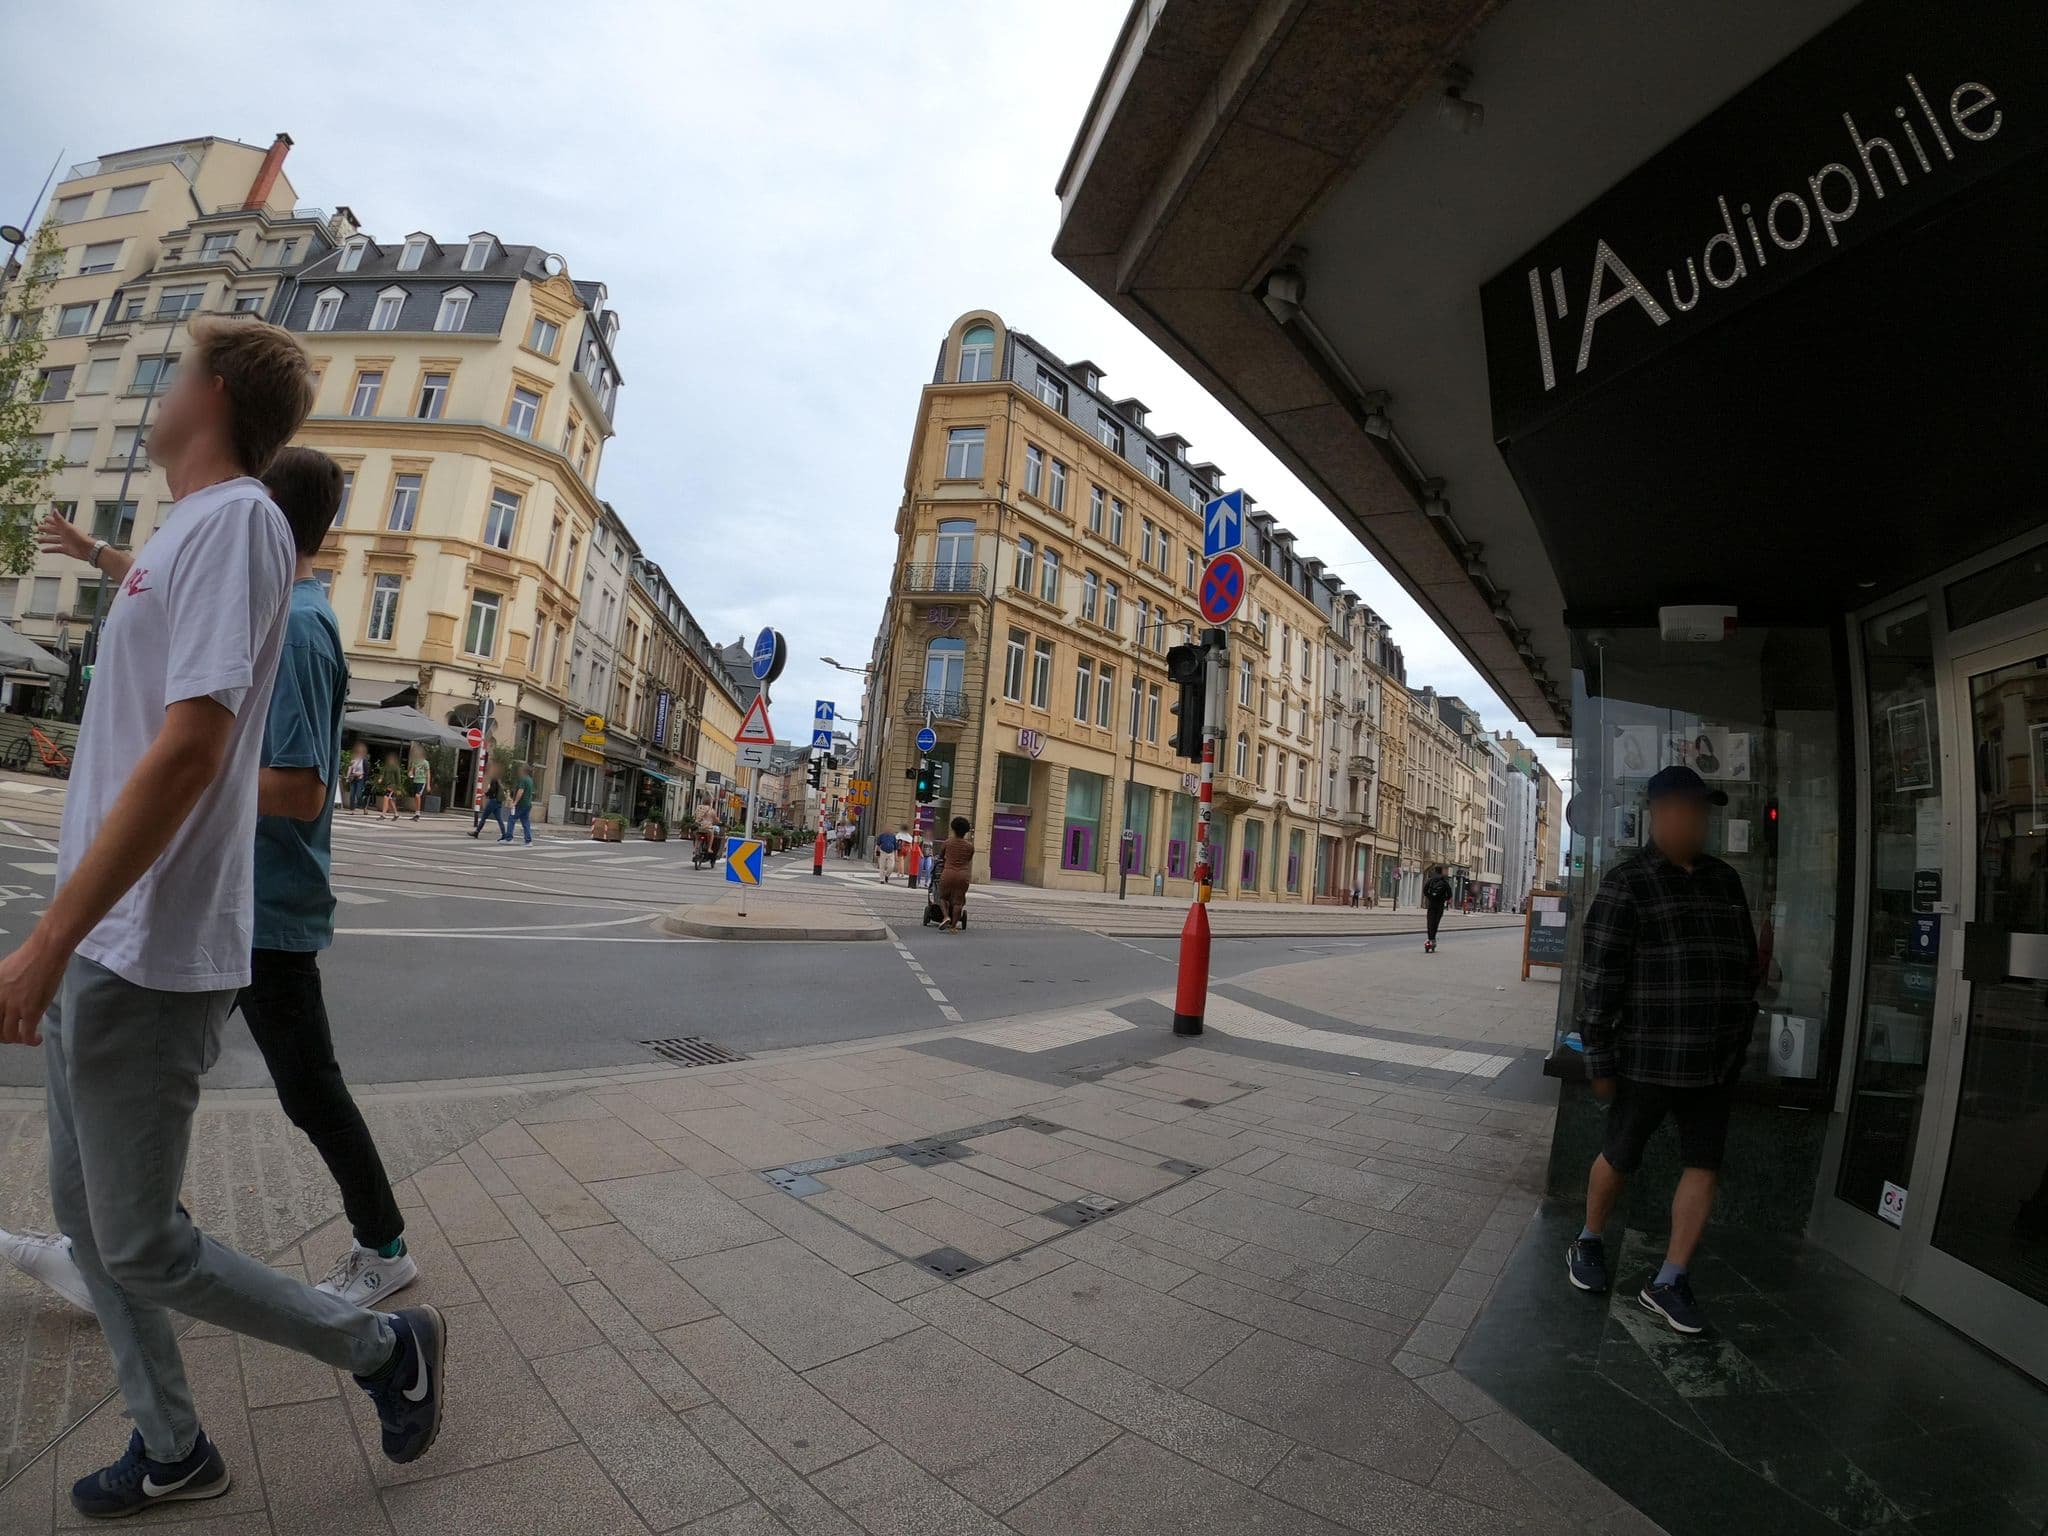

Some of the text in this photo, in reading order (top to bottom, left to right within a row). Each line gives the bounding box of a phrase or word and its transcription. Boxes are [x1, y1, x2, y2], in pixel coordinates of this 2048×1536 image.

[1528, 73, 2003, 391] l'Audiophile
[928, 606, 955, 623] BIL
[1021, 729, 1039, 750] BIL
